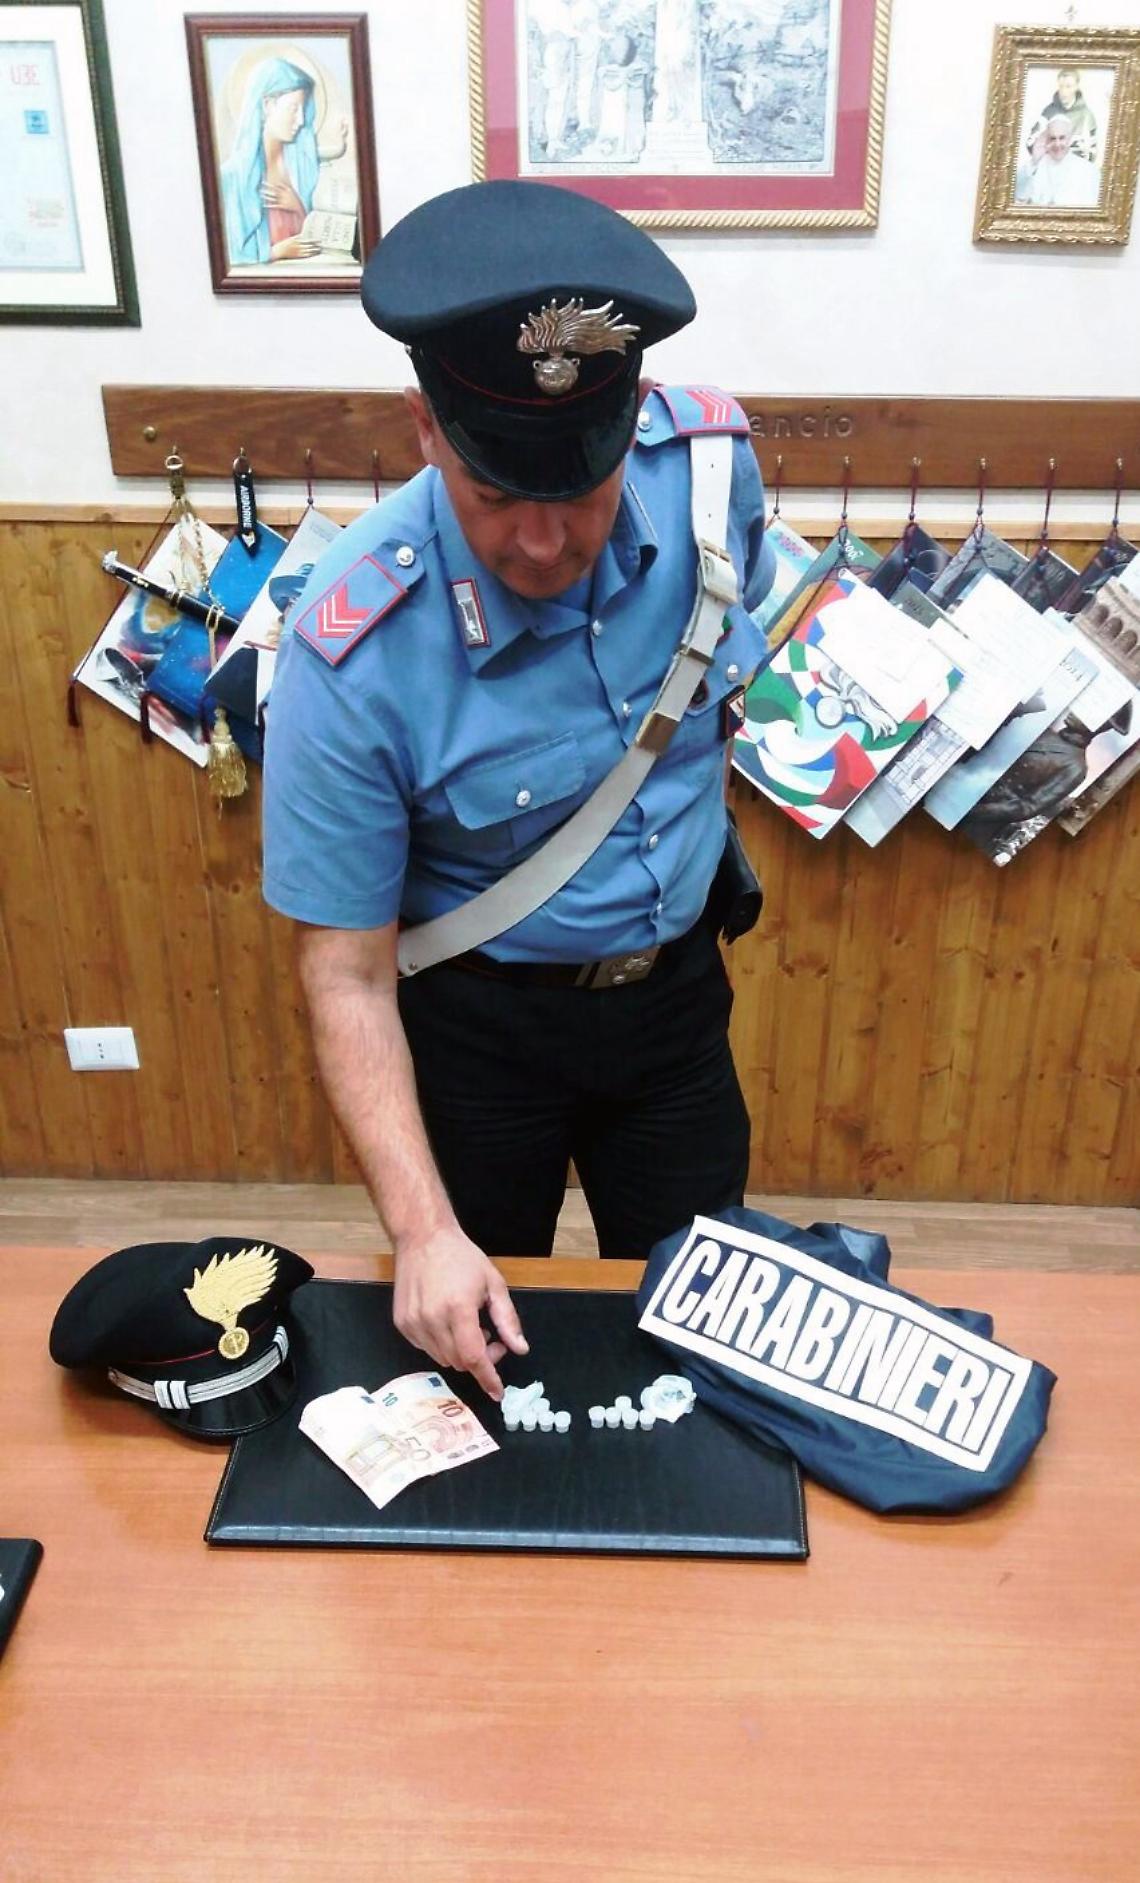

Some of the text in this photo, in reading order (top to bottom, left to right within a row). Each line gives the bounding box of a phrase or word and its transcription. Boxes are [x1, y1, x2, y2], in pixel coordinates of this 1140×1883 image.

[240, 485, 253, 528] AIRBORNE
[660, 1239, 1014, 1453] CARABINIERI
[382, 1392, 399, 1407] 10
[437, 1400, 464, 1418] 10
